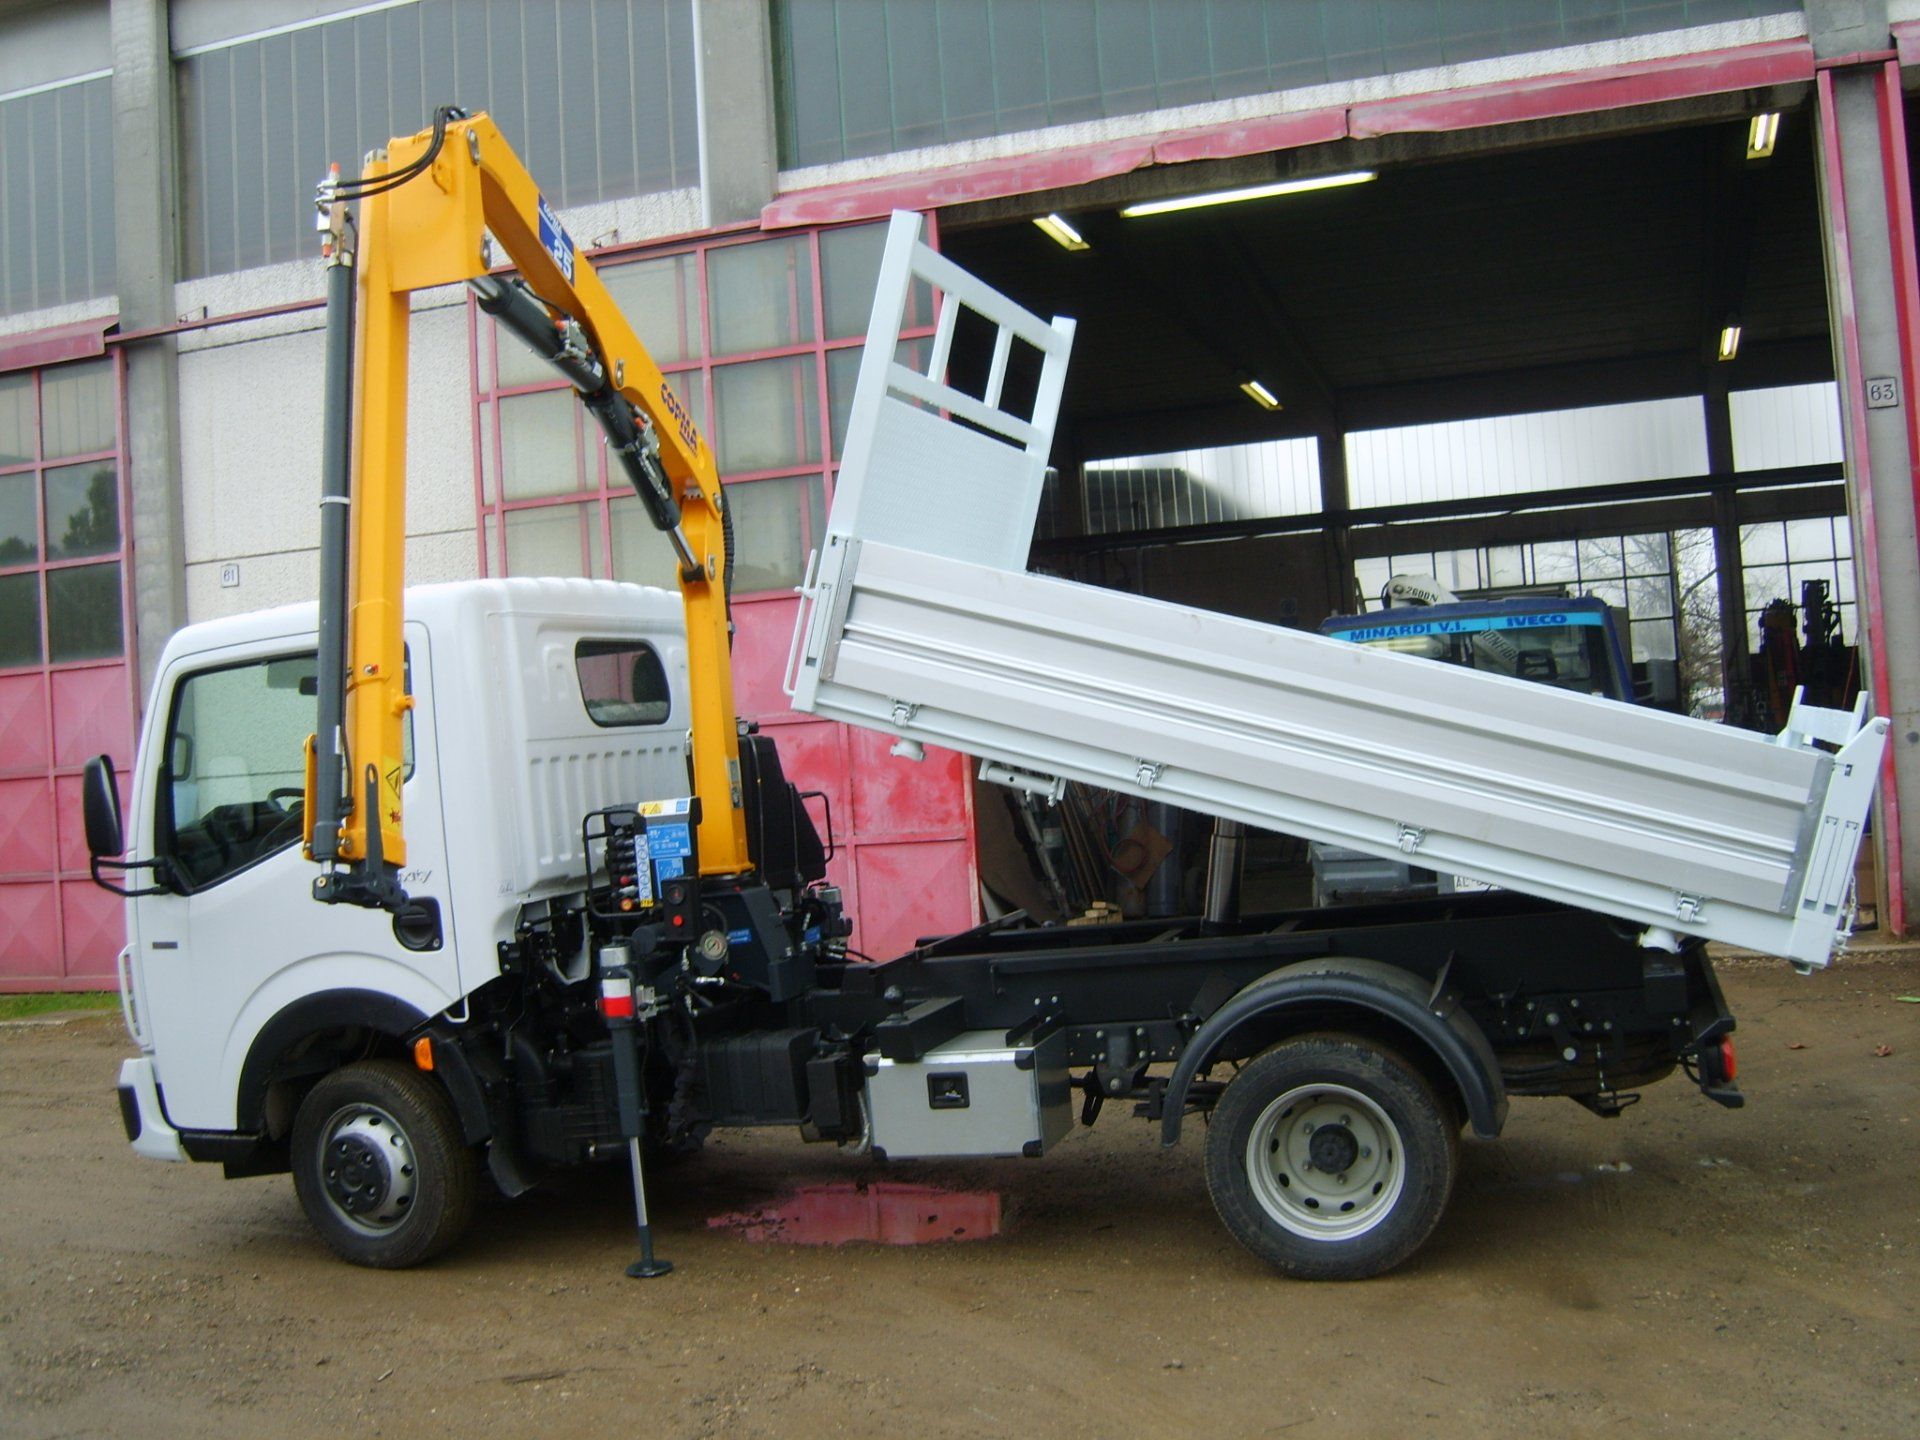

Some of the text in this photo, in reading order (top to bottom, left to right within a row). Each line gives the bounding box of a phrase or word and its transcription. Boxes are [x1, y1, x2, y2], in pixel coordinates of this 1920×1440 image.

[553, 238, 573, 281] 25
[1870, 384, 1894, 401] 63
[661, 383, 698, 452] COPMA
[1350, 623, 1431, 641] MINARDI
[1506, 613, 1568, 627] IVECO
